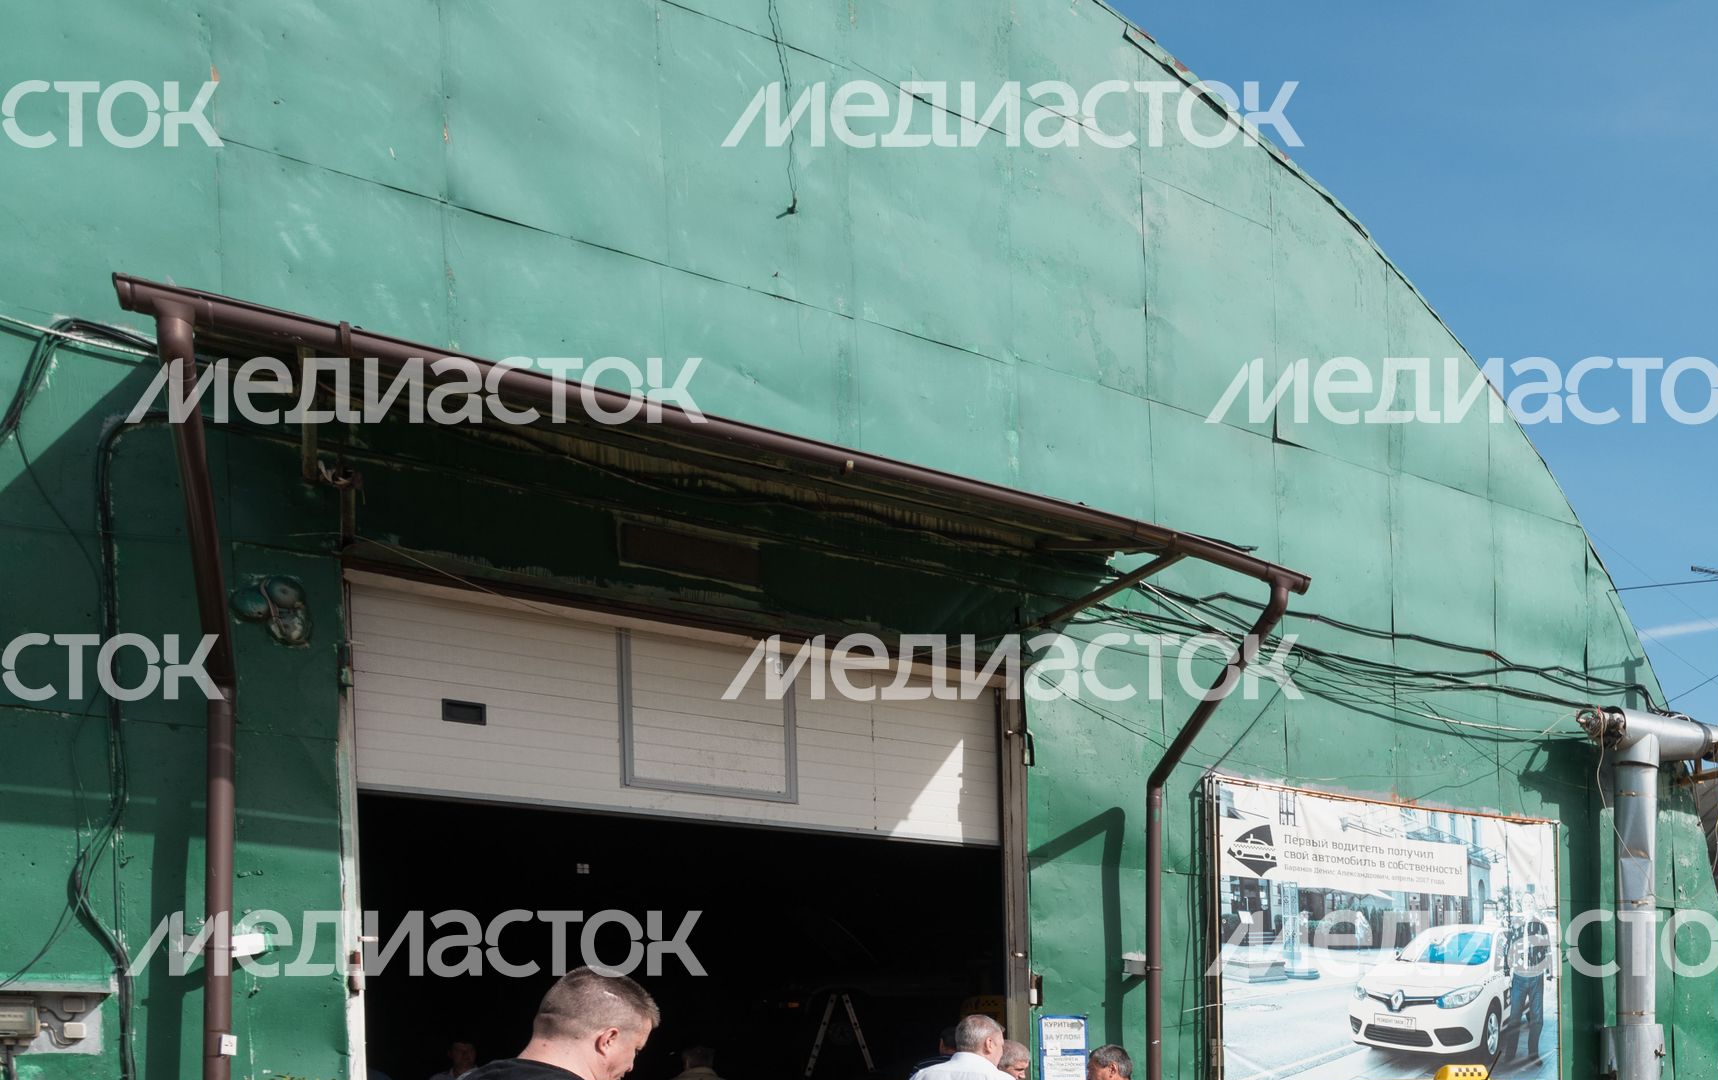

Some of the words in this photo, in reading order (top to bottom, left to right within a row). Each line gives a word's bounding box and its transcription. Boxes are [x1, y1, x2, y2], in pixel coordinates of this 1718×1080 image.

[1283, 834, 1329, 850] Первый
[1332, 841, 1384, 855] водитель
[1387, 847, 1434, 860] получил
[1283, 849, 1309, 861] свой
[1312, 851, 1377, 868] автомобиль
[1388, 861, 1463, 875] собственность!
